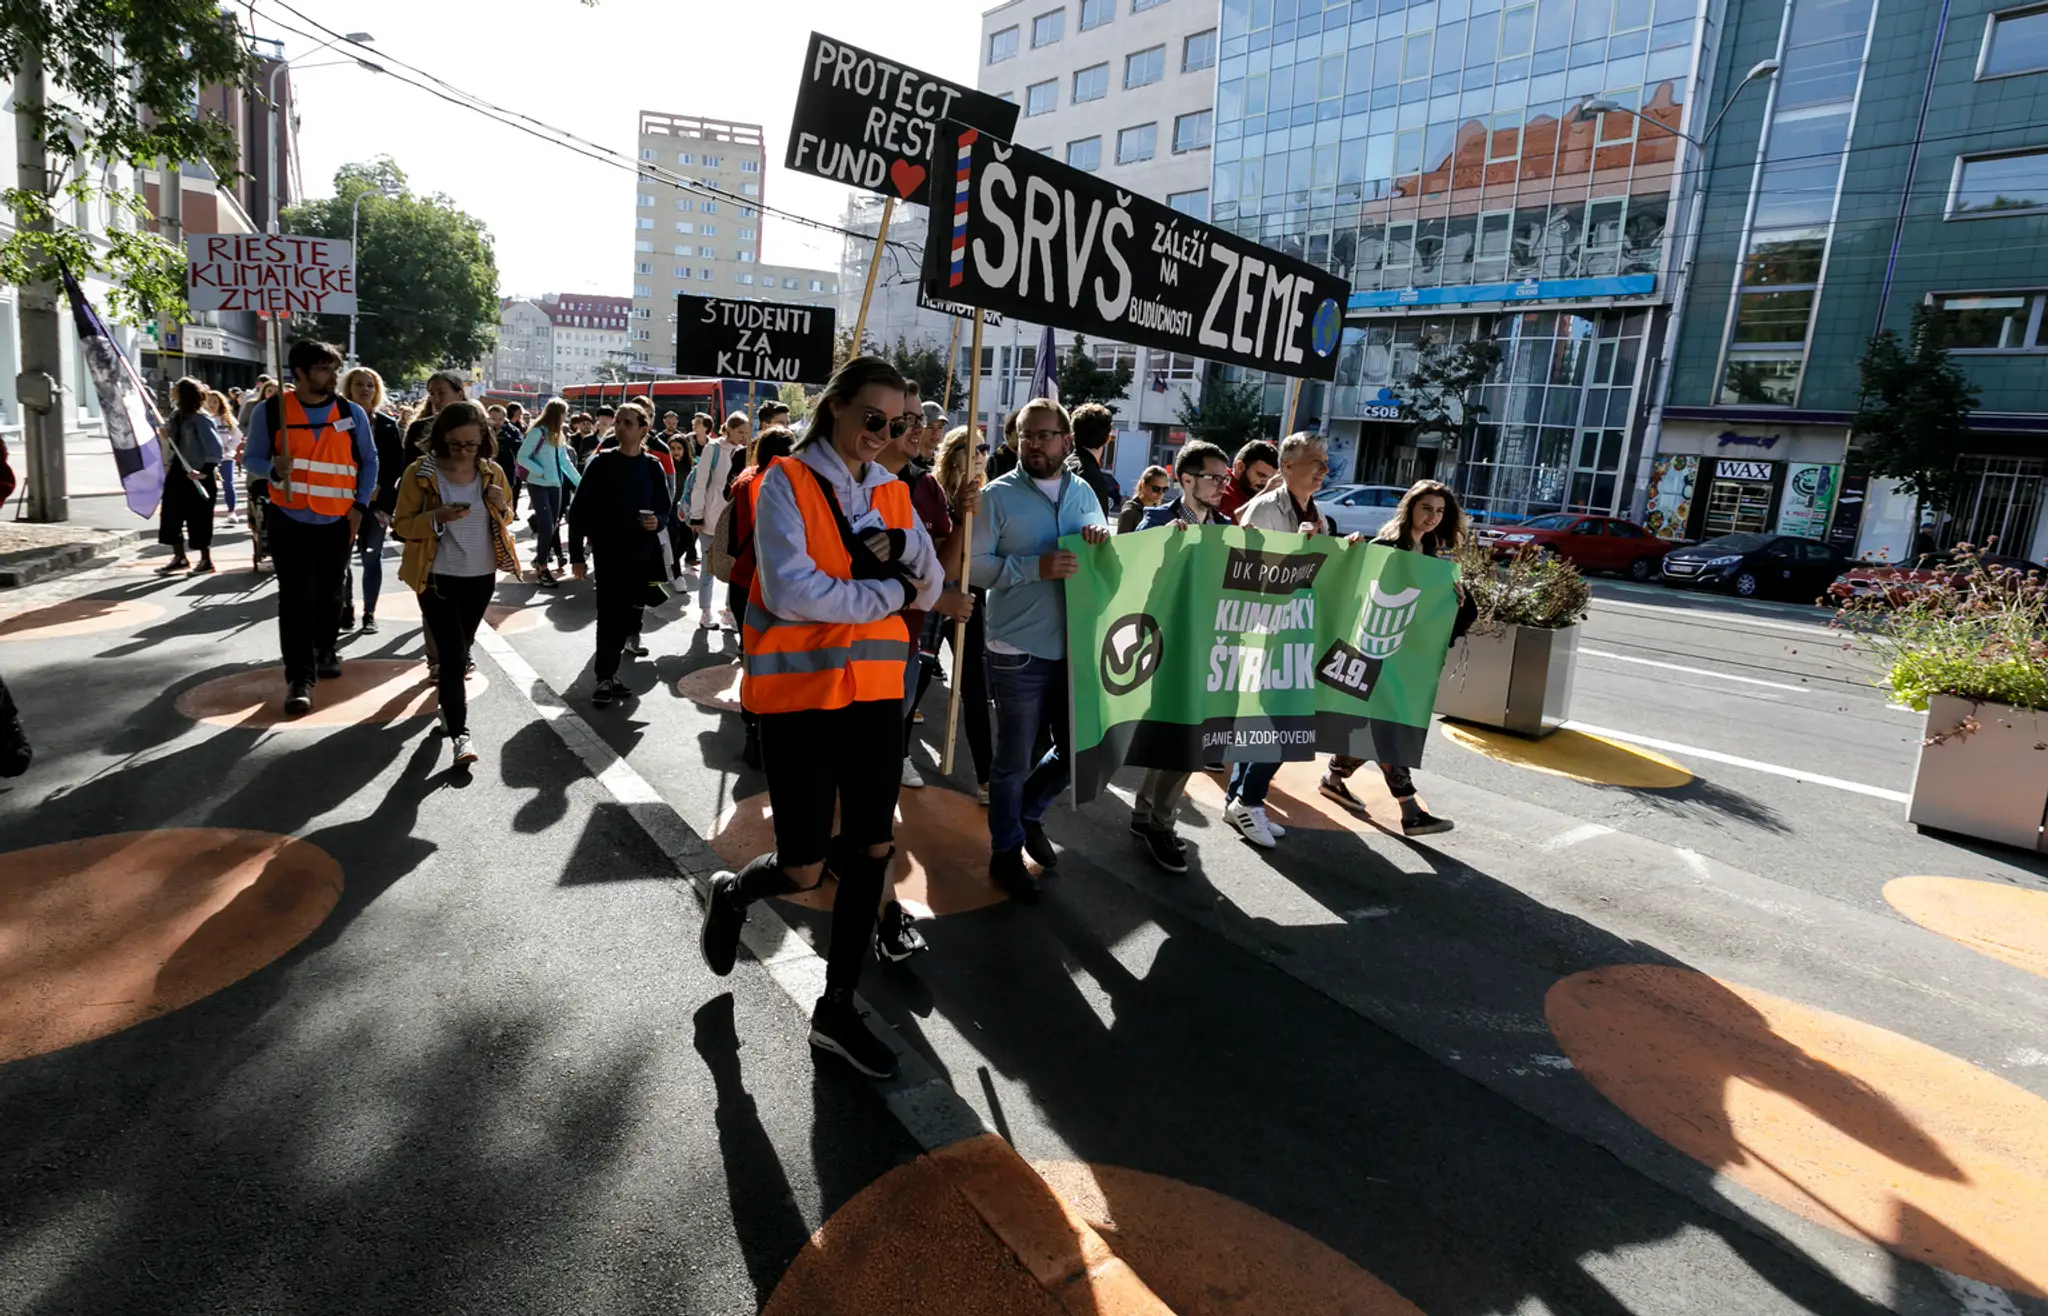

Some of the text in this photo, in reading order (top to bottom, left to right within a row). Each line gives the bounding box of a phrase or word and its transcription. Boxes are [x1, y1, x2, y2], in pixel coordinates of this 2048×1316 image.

[813, 40, 962, 118] PROTECT
[794, 132, 887, 188] FUND
[972, 142, 1134, 321] ŠRVŠ
[1151, 218, 1208, 268] ZÁLEŽÍ
[208, 234, 329, 267] RIEŠTE
[191, 262, 353, 293] KLIMATICKÉ
[1160, 257, 1178, 287] NA
[218, 288, 331, 312] ZMENY
[1129, 294, 1192, 338] BUDÚCNOSTI
[1198, 243, 1315, 364] ZEME
[701, 299, 811, 334] ŠTUDENTI
[736, 330, 772, 355] ZA
[716, 350, 800, 381] KLÍMU
[1720, 461, 1770, 479] WAX
[1232, 561, 1256, 580] UK
[1235, 731, 1247, 746] AJ
